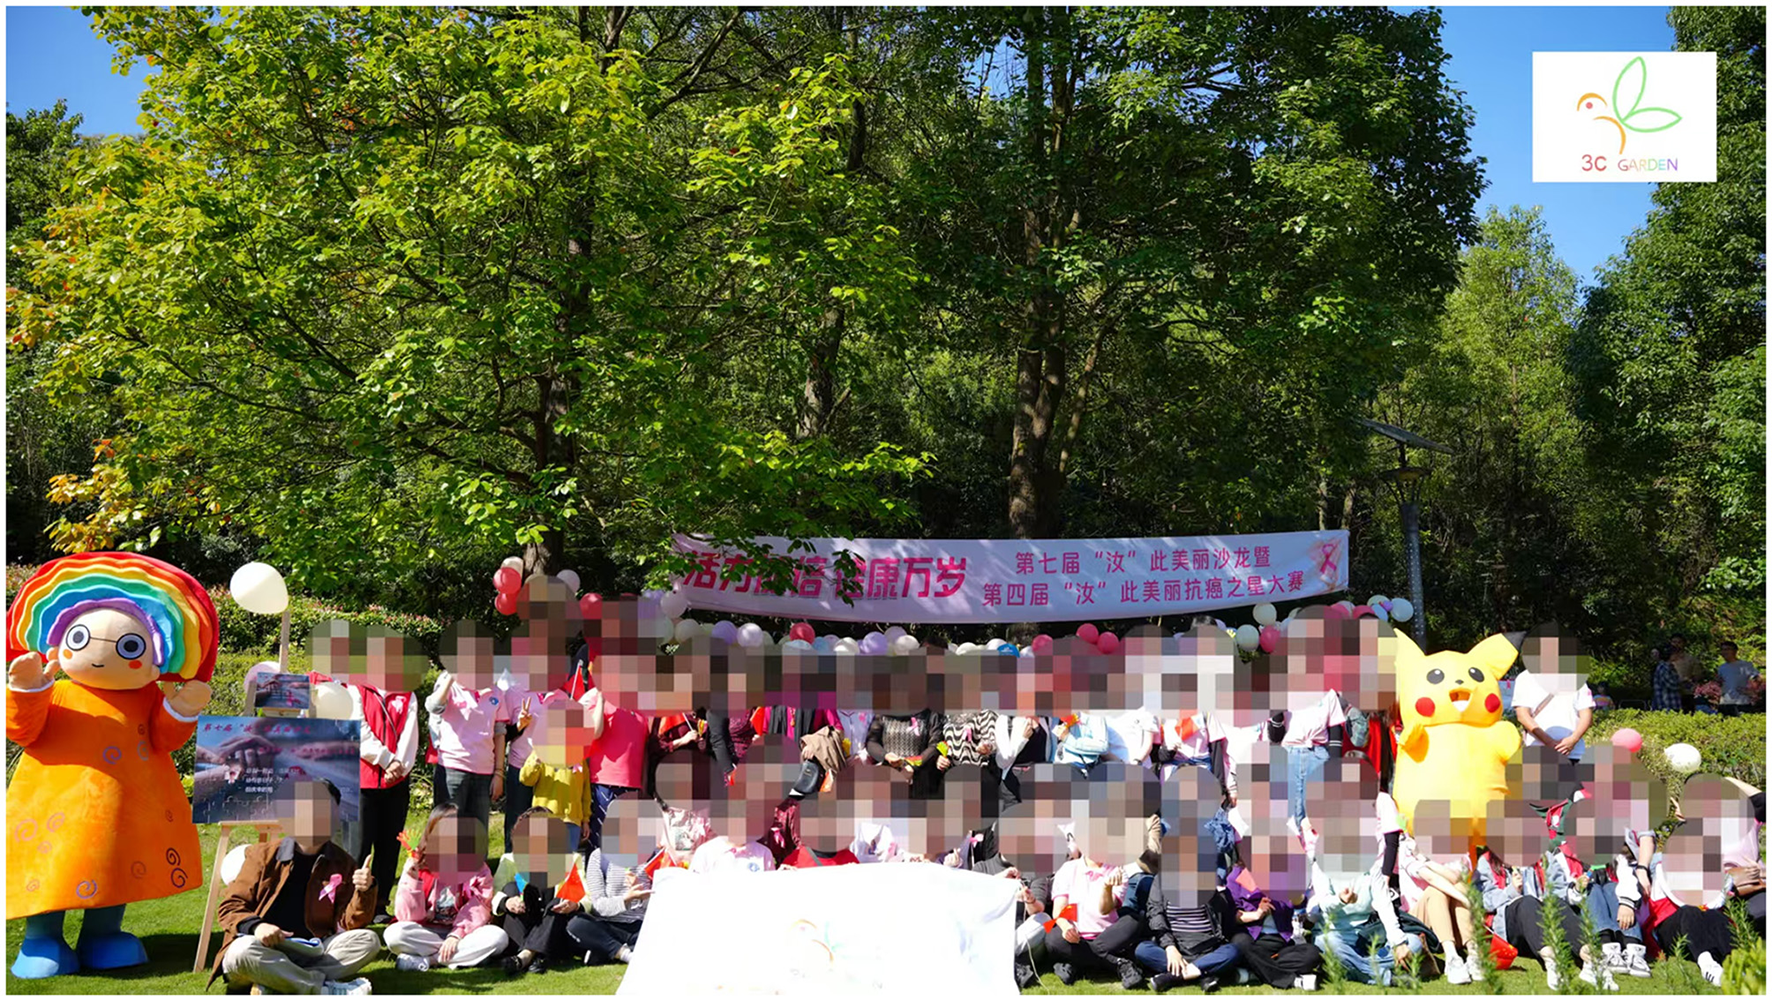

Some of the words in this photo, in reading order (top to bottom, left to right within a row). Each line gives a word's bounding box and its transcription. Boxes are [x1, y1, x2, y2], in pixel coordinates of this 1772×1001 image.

[683, 550, 827, 598] 活力倍
[1015, 546, 1271, 575] 第七届“汝”此美丽沙龙暨
[982, 571, 1304, 607] 第四届“汝”此美丽抗癌之星大赛
